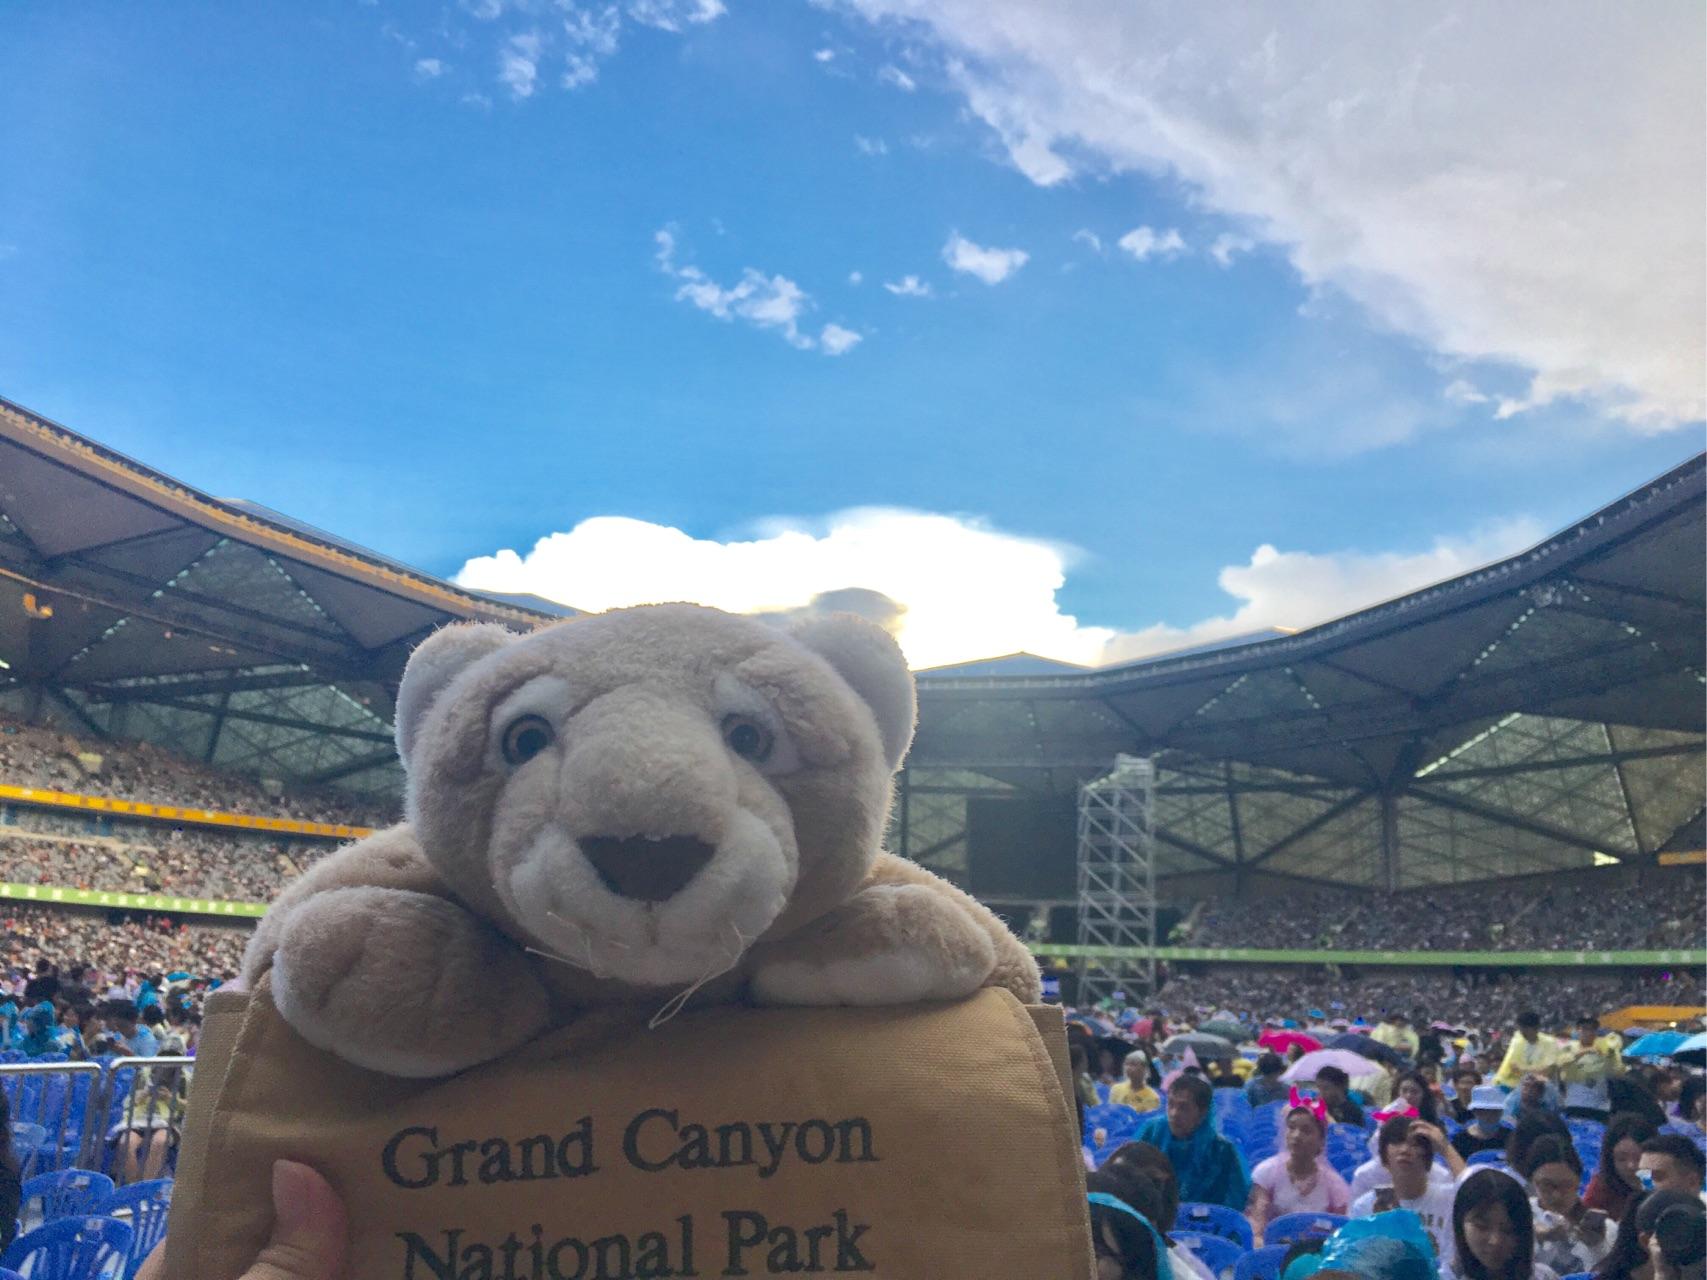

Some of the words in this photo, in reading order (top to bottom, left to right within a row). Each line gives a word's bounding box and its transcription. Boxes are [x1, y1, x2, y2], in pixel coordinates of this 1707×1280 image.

[382, 1116, 600, 1188] Grand
[622, 1108, 880, 1178] Canyon
[395, 1214, 700, 1280] National
[721, 1208, 875, 1276] Park
